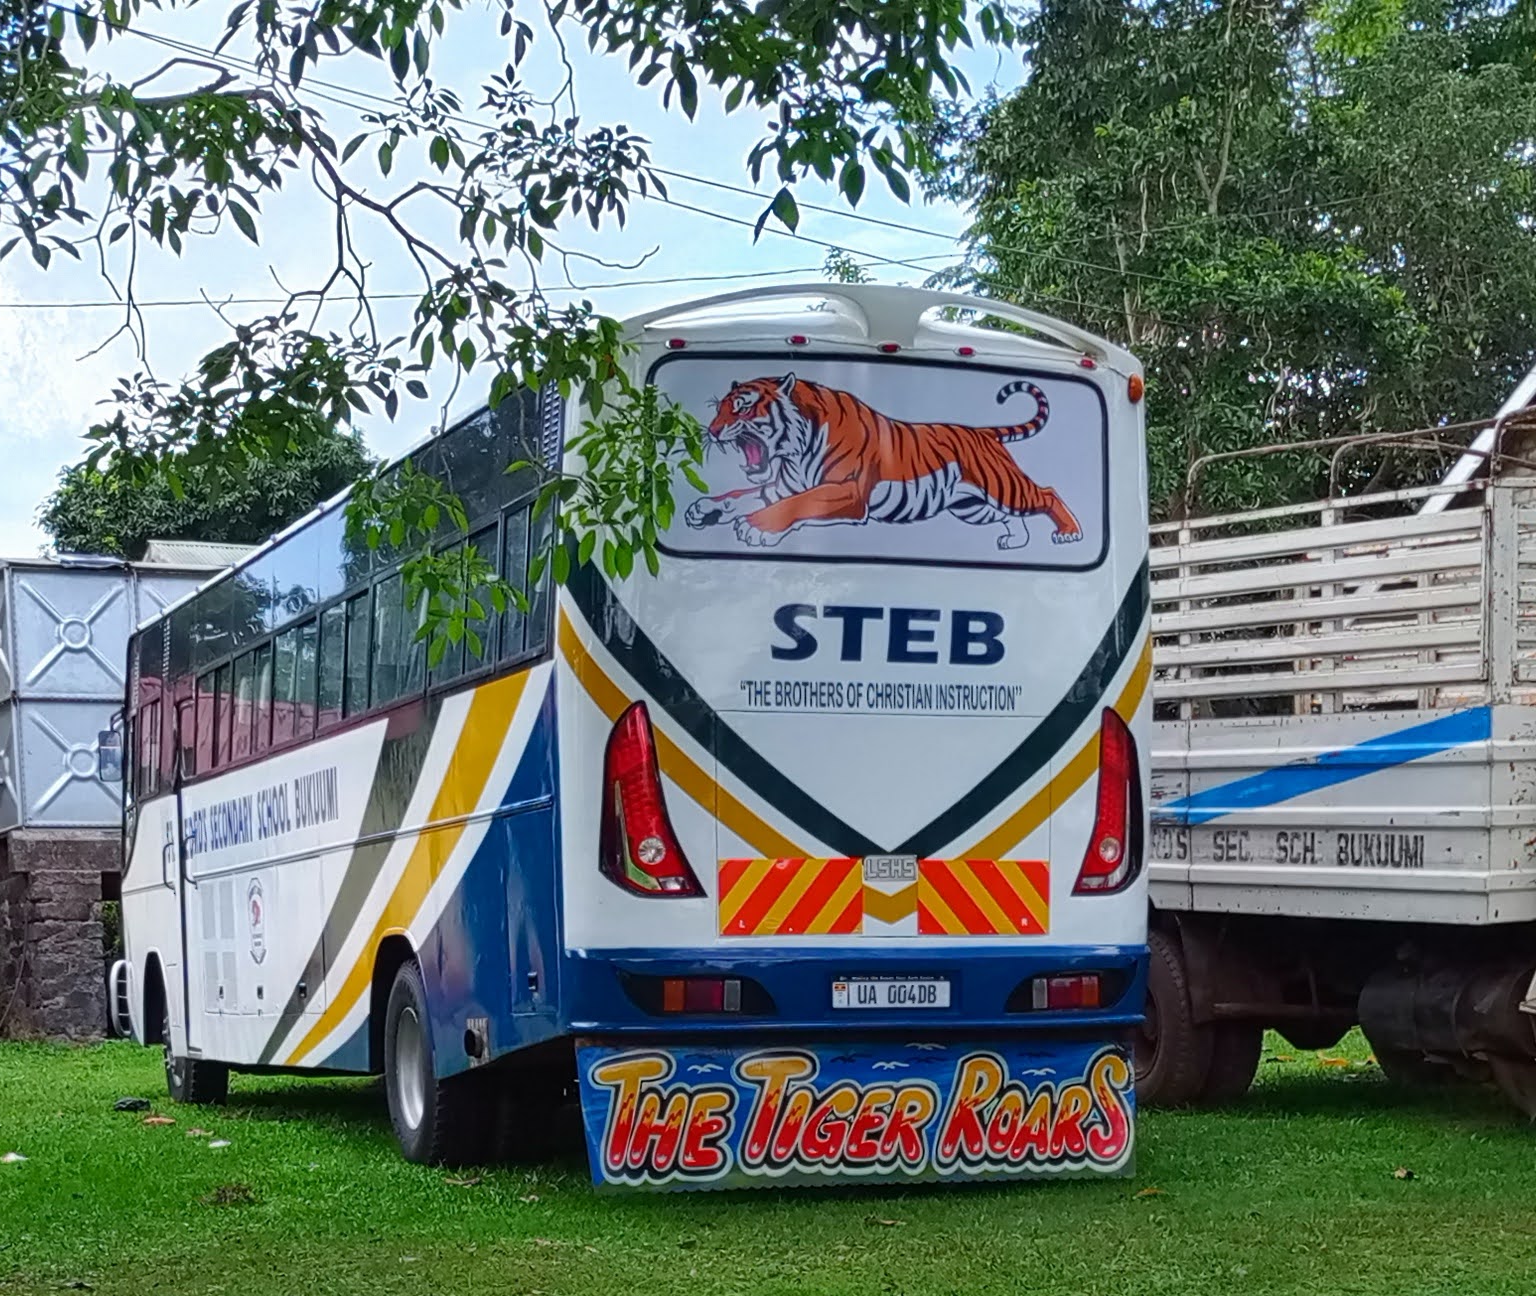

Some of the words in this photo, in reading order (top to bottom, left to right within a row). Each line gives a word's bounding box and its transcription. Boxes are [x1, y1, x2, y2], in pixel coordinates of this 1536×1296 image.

[770, 603, 1006, 666] STEB
[774, 681, 844, 708] BROTHERS
[846, 683, 864, 707] OF
[866, 683, 933, 710] CHRISTIAN
[210, 794, 254, 851] SECONDARY
[257, 782, 292, 840] SCHOOL
[294, 766, 339, 830] BUKUUMI
[865, 858, 917, 880] LSHS
[1336, 832, 1425, 869] BUKUUMI
[857, 984, 877, 1005] UA
[588, 1053, 737, 1182] THE
[732, 1052, 939, 1176] TIGER
[936, 1046, 1134, 1174] ROARS
